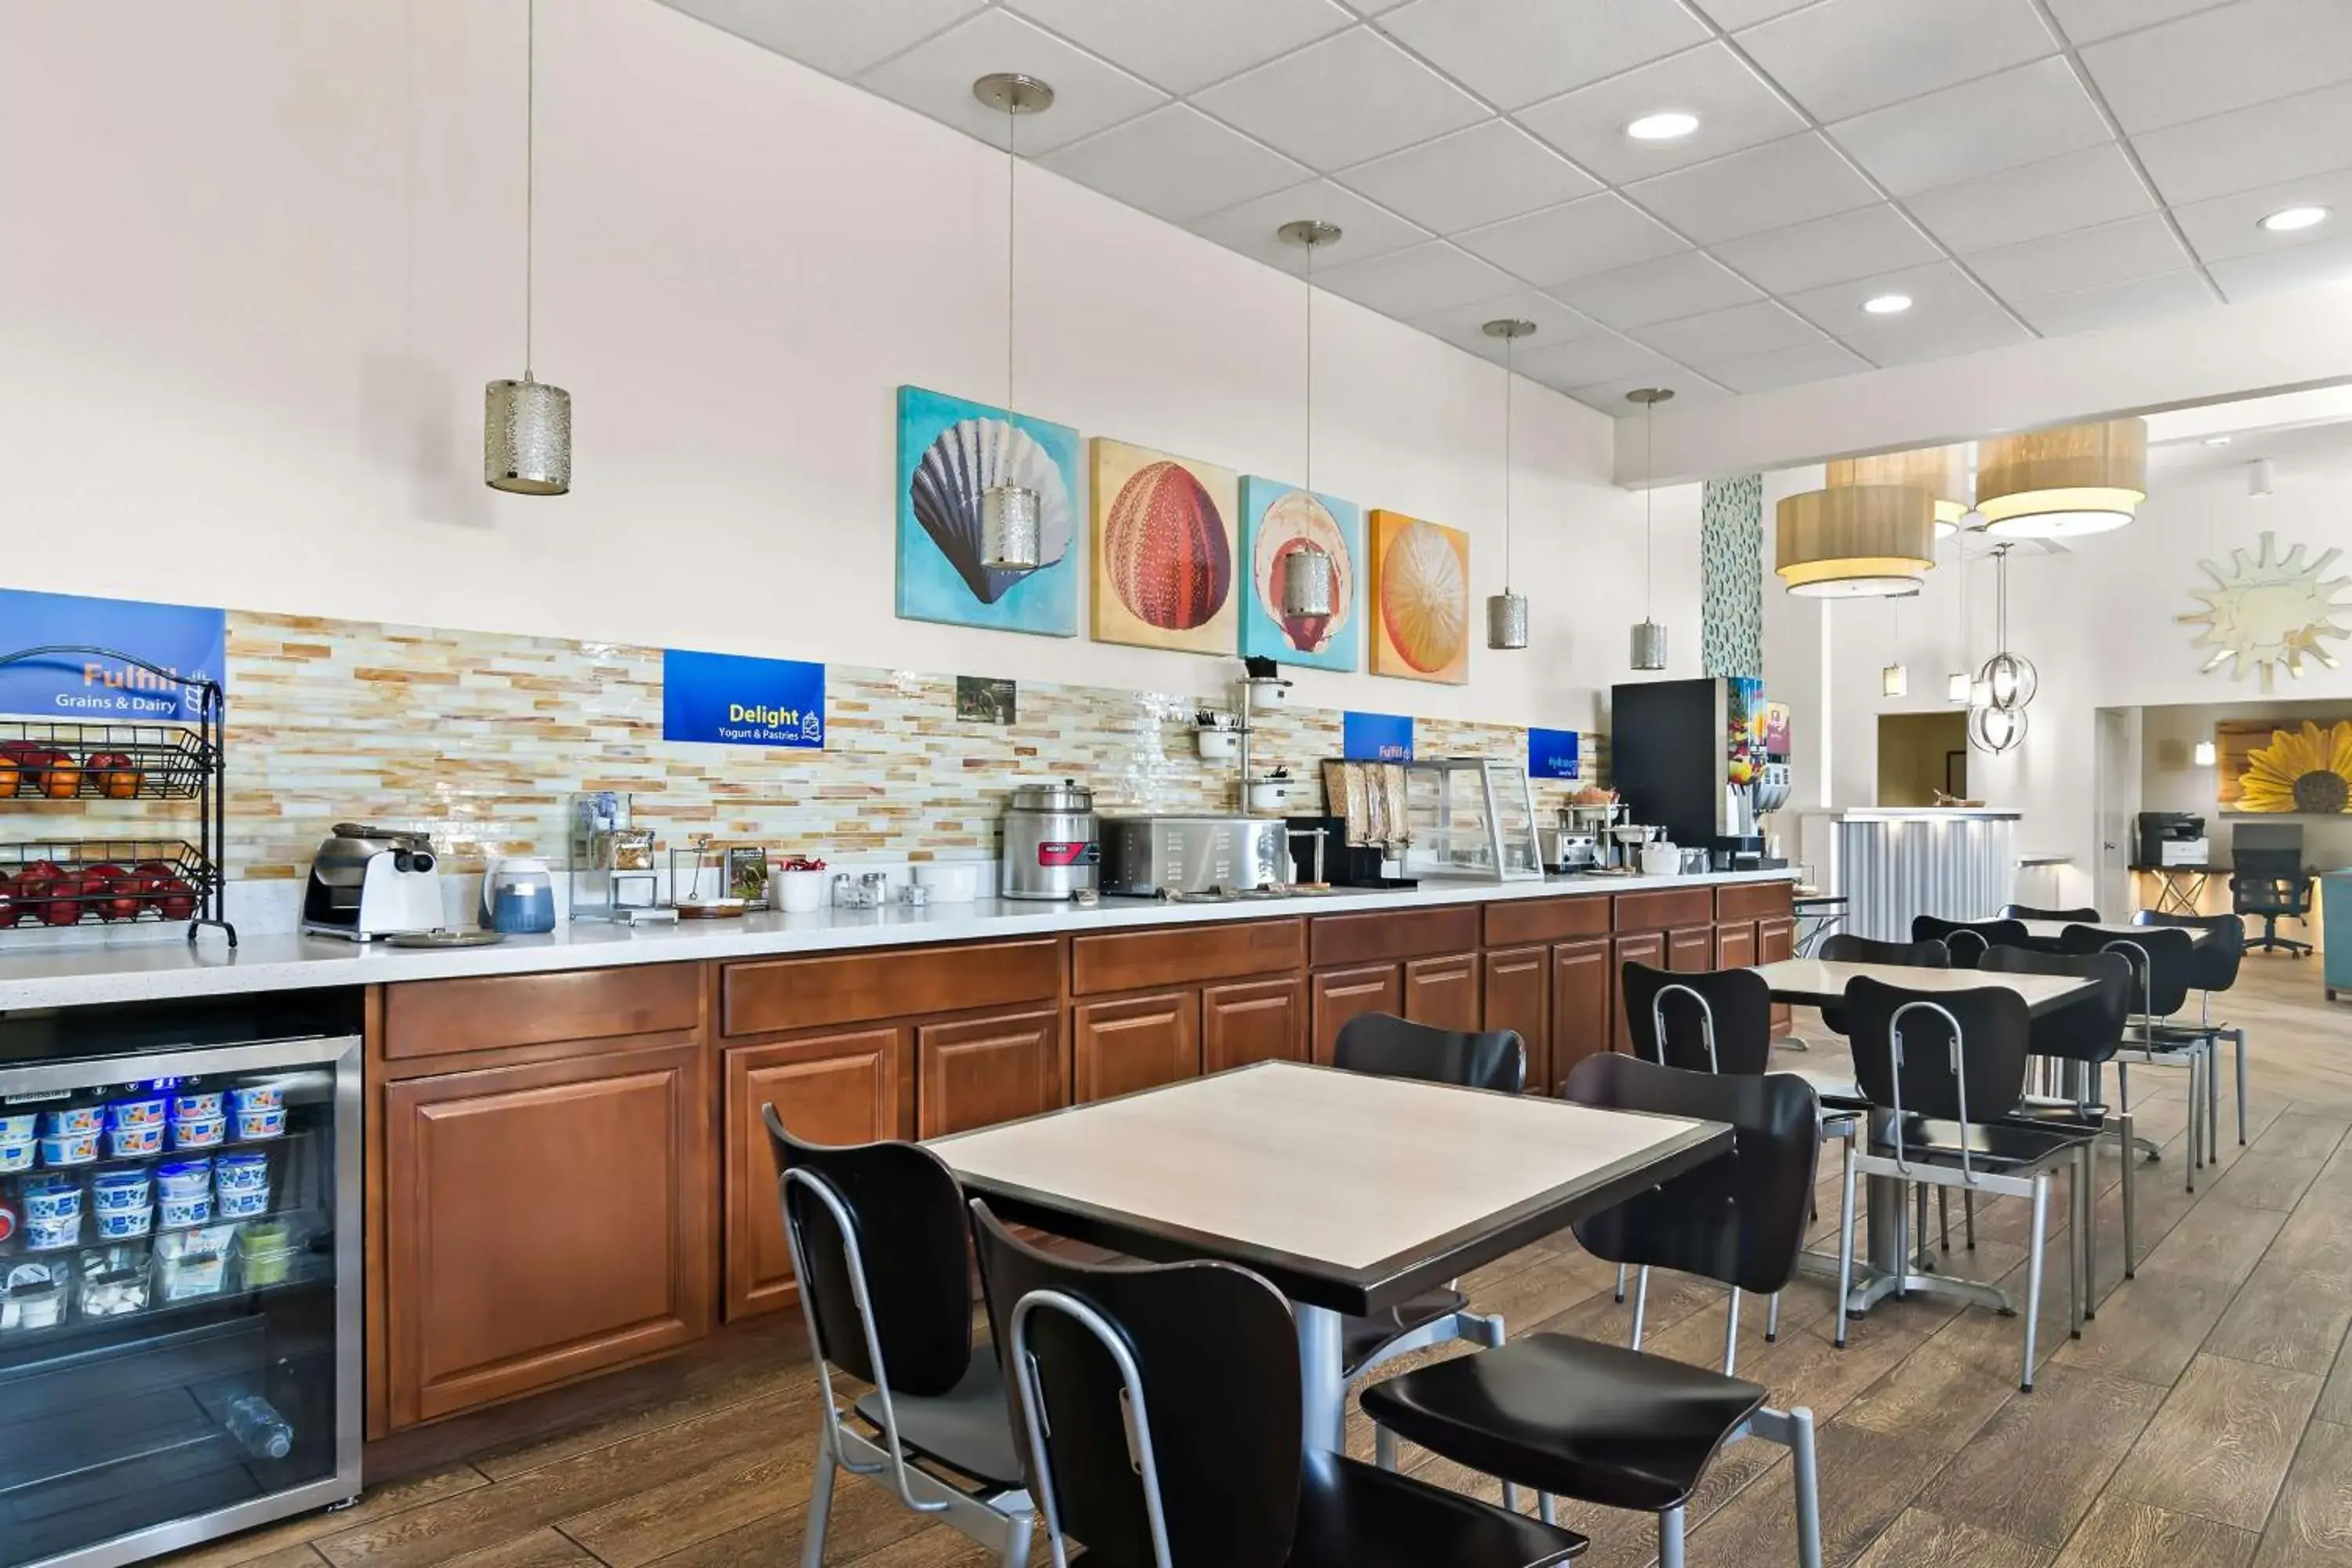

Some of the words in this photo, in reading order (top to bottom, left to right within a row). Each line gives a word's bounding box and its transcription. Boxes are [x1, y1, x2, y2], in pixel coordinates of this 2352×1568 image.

[56, 693, 111, 710] Grains
[116, 695, 129, 710] &
[133, 697, 176, 714] Dairy
[729, 703, 799, 728] Delight
[718, 728, 751, 739] Yogurt
[753, 729, 761, 739] &
[763, 730, 799, 741] Pastries
